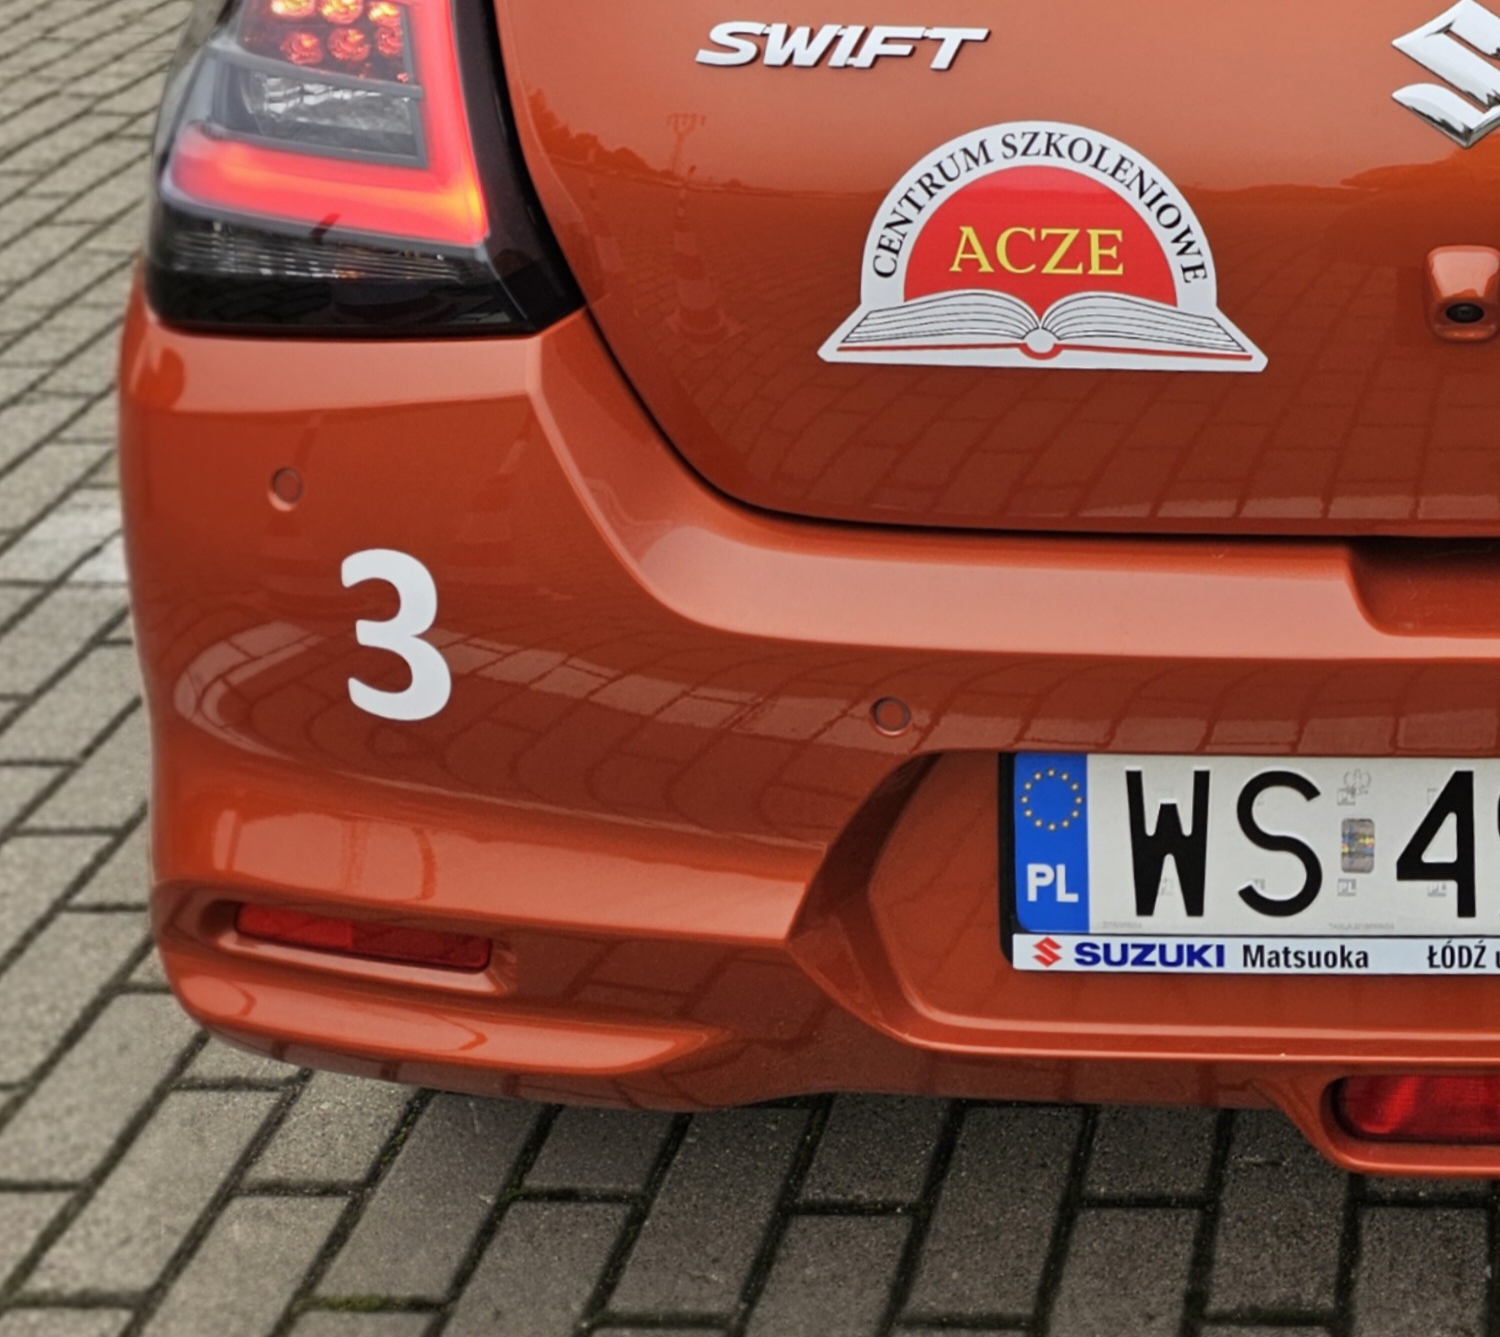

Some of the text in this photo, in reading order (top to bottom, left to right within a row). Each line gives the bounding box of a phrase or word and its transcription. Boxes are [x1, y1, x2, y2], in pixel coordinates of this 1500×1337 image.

[694, 20, 990, 71] SWIFT
[872, 130, 1208, 285] CENTRUM SZKOLENIOWE
[948, 225, 1125, 277] ACZE
[340, 548, 452, 721] 3
[1124, 769, 1324, 918] WS
[1026, 863, 1079, 903] PL
[1074, 941, 1226, 968] SUZUKI
[1242, 943, 1370, 970] Matsuoka
[1427, 939, 1487, 969] ŁÓDŹ
